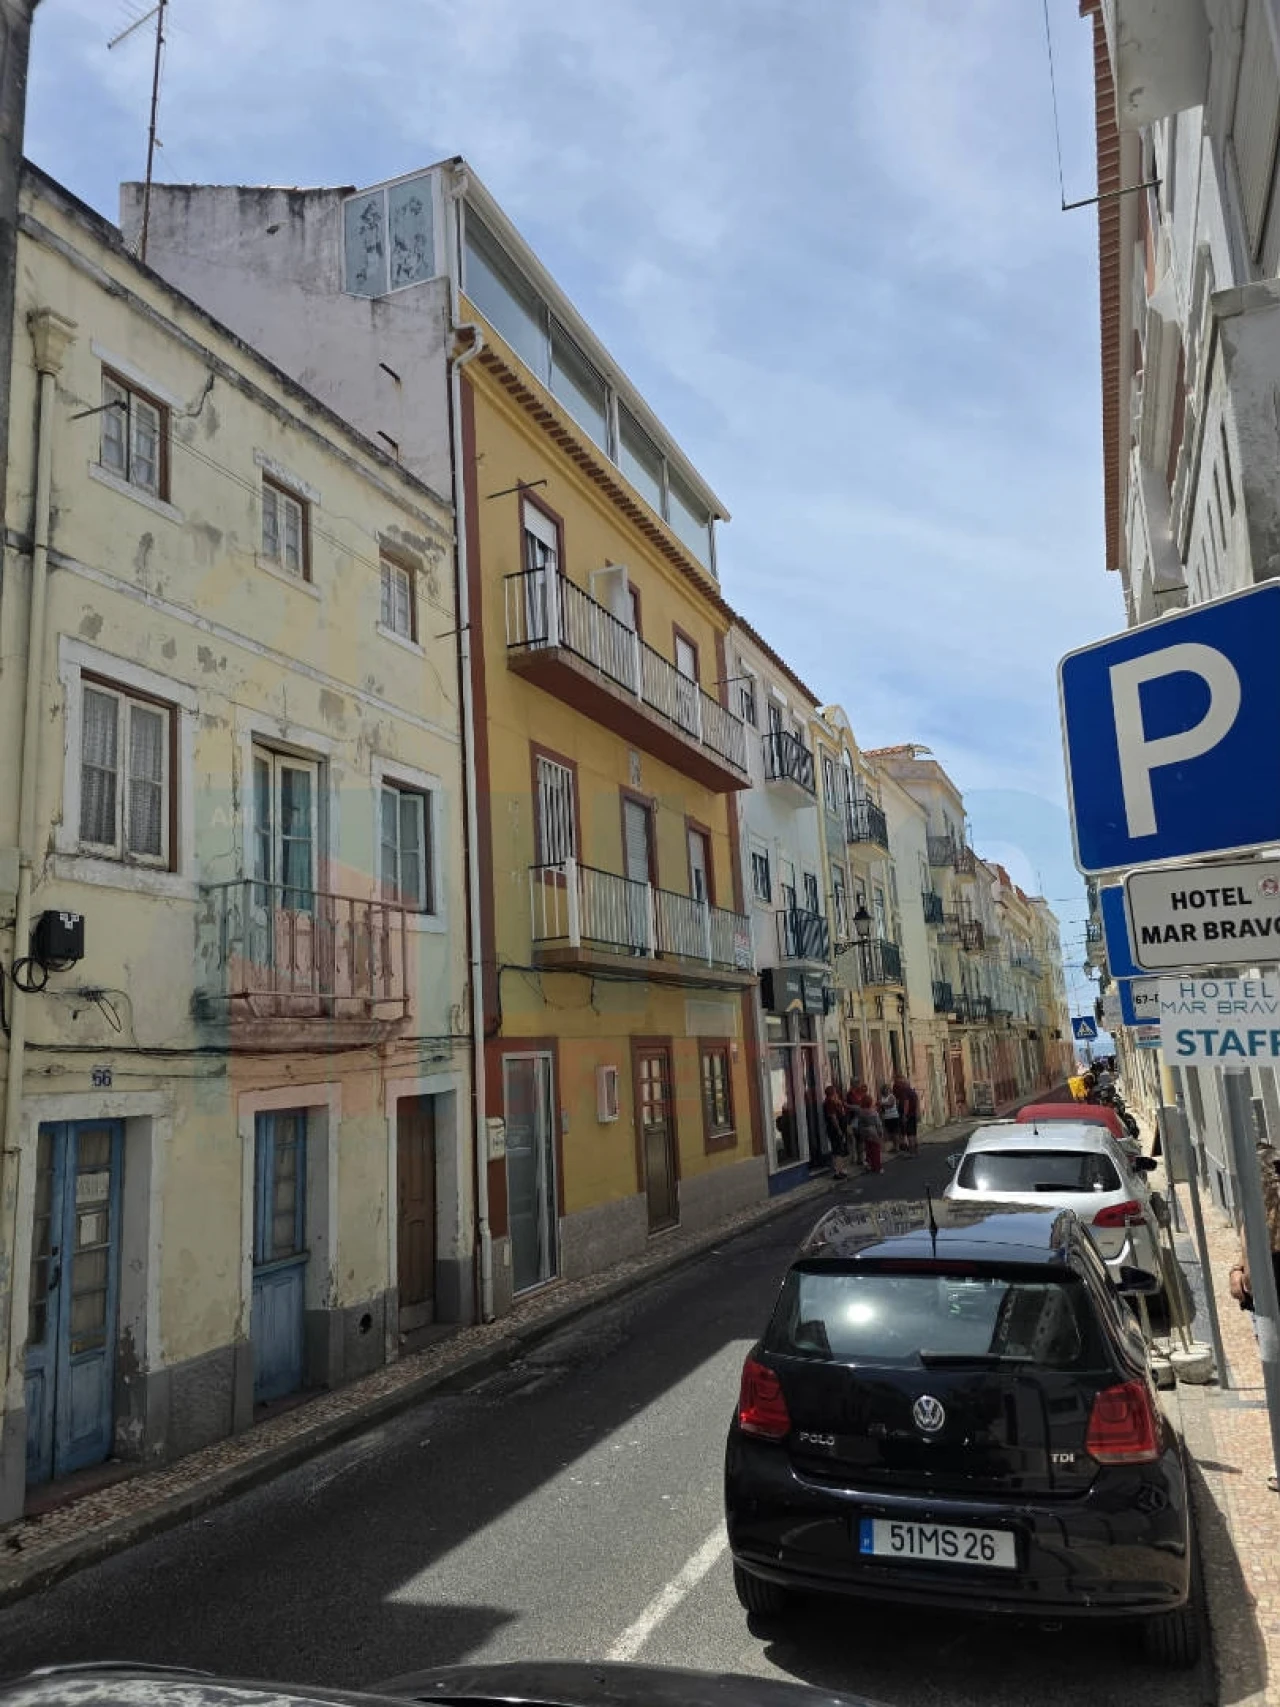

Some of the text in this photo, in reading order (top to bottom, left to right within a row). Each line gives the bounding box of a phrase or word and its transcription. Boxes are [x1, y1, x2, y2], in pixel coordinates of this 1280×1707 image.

[1109, 642, 1242, 839] P
[1171, 887, 1253, 911] HOTEL
[1141, 923, 1198, 944] MAR
[1180, 981, 1275, 998] HOTEL
[1160, 1001, 1207, 1014] MAR
[1051, 1453, 1075, 1463] TDI
